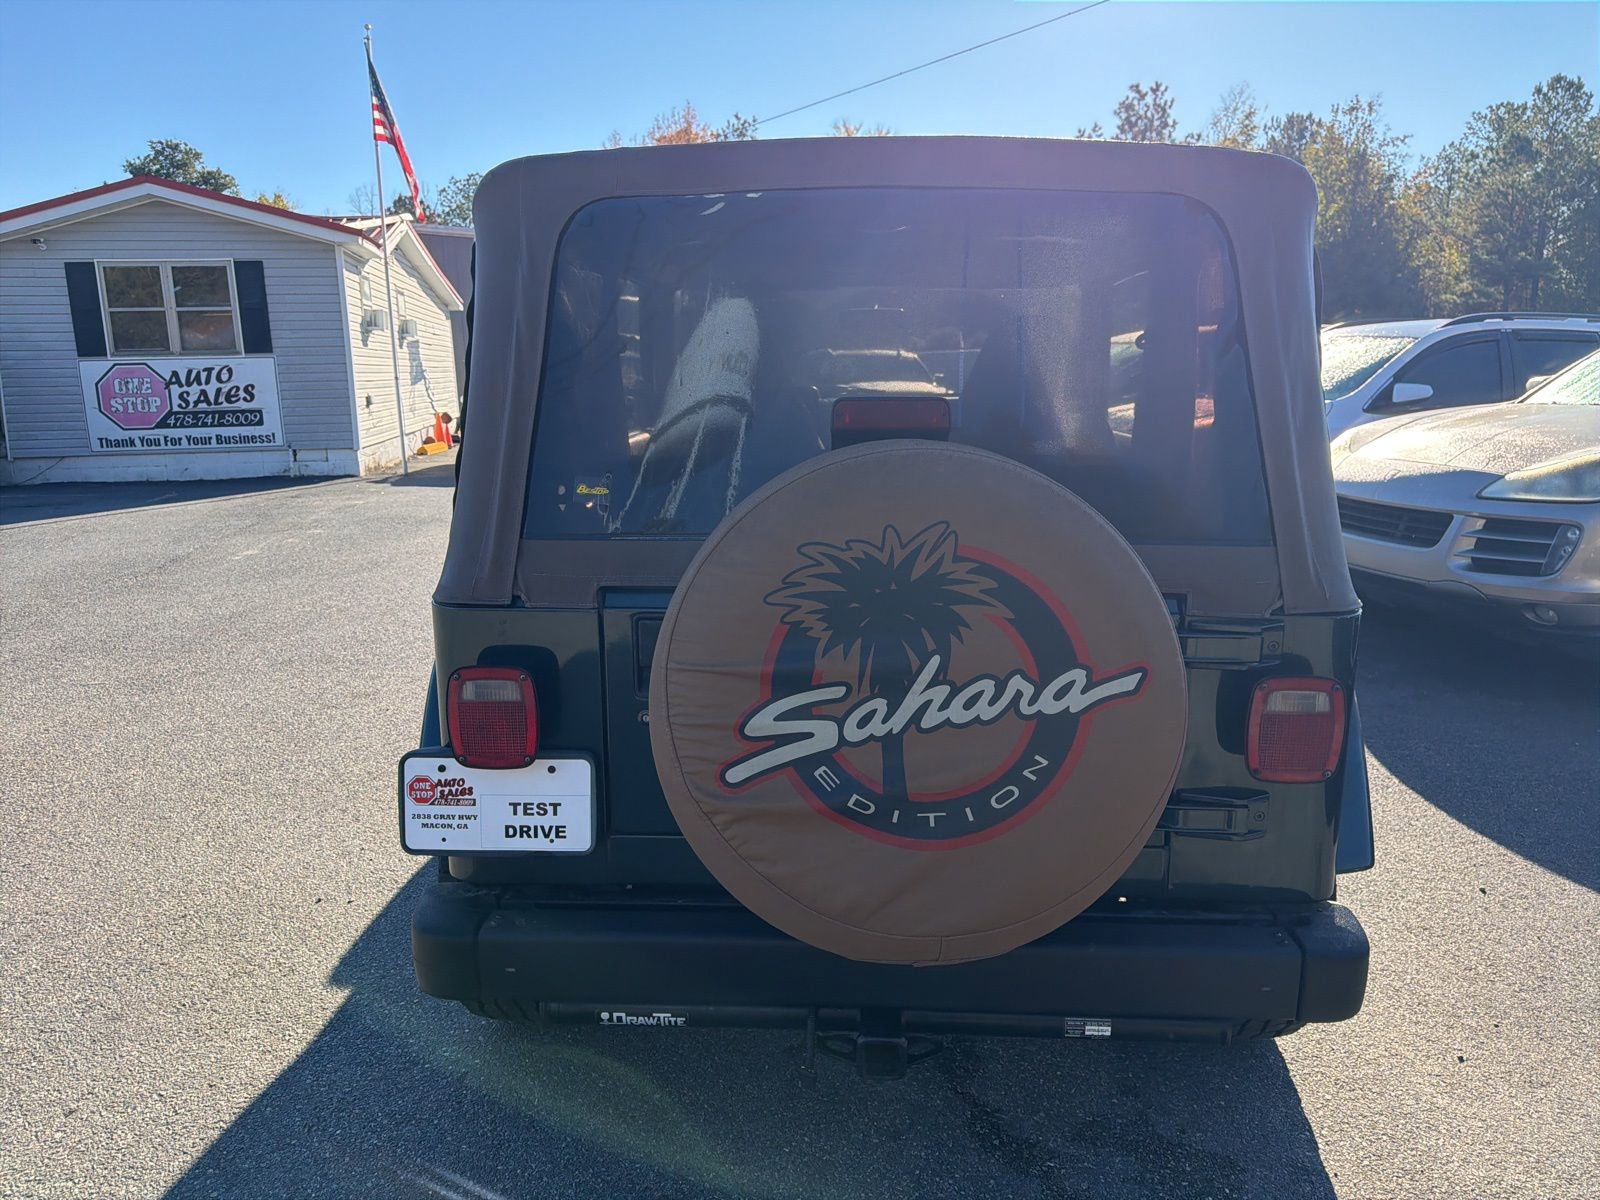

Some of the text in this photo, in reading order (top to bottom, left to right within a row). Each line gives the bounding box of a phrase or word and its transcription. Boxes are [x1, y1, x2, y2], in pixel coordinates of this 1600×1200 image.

[164, 365, 234, 390] AUTO
[113, 377, 152, 395] ONE
[177, 383, 256, 410] SALES
[110, 396, 161, 414] STOP
[166, 412, 260, 428] 478-741-8009
[97, 432, 276, 449] Thank You For Your Business!
[724, 653, 1144, 784] Sahara
[413, 782, 431, 790] ONE
[435, 777, 466, 790] AUTO
[813, 754, 1050, 828] EDITION
[411, 790, 433, 799] STOP
[438, 786, 474, 800] SALES
[508, 802, 562, 817] TEST
[421, 822, 456, 831] MACON,
[504, 824, 567, 839] DRIVE
